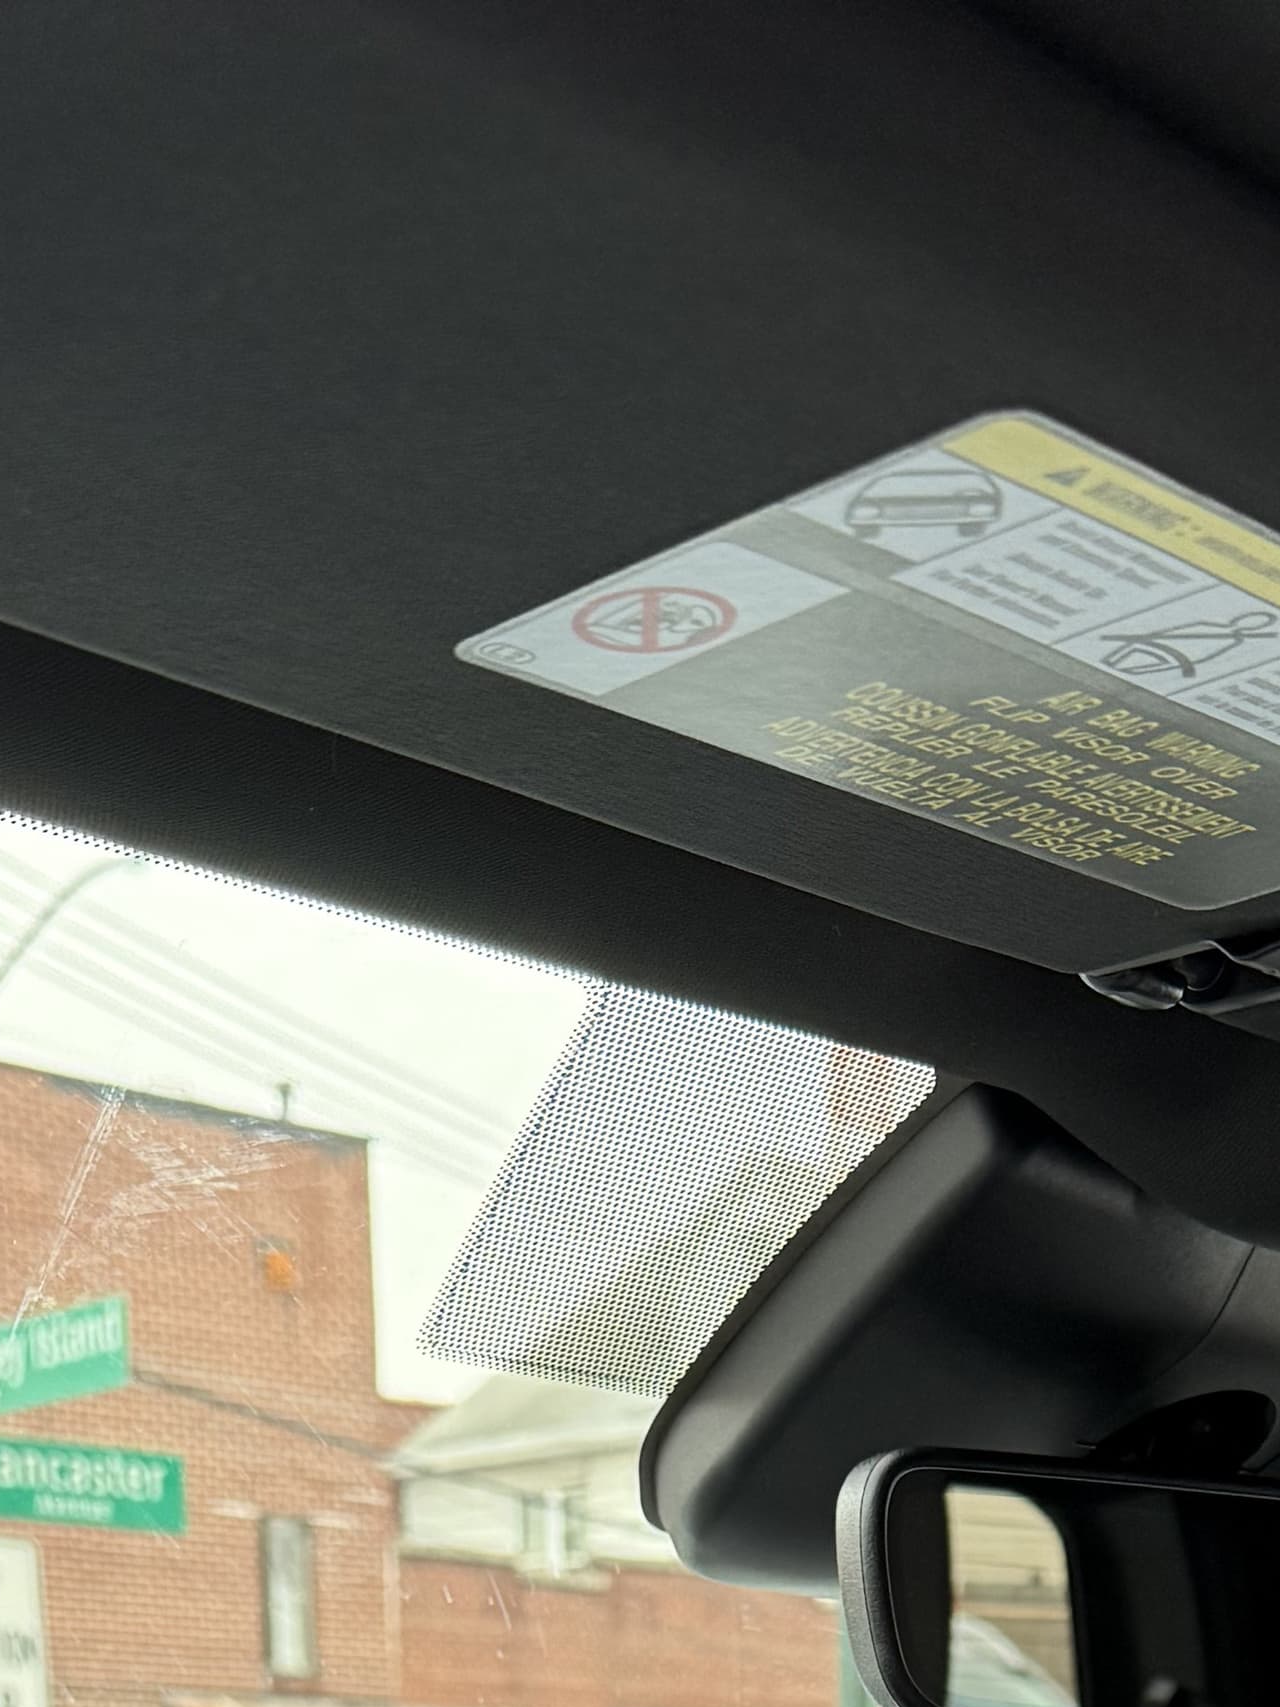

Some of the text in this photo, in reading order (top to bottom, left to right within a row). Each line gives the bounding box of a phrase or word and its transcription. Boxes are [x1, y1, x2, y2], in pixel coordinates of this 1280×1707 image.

[765, 716, 1175, 866] ADVERTENCIA CON LA BOLSA DE AIRE
[830, 706, 1197, 845] REPLIER LE PARESOLEIL
[847, 681, 969, 731] COUSSIN
[1074, 773, 1257, 839] AVERTISSEMENT
[969, 695, 1239, 800] FLIP VISOR OVER
[1039, 691, 1262, 779] AIR BAG WARNING
[774, 745, 1103, 862] DE VUELTA AL VISOR
